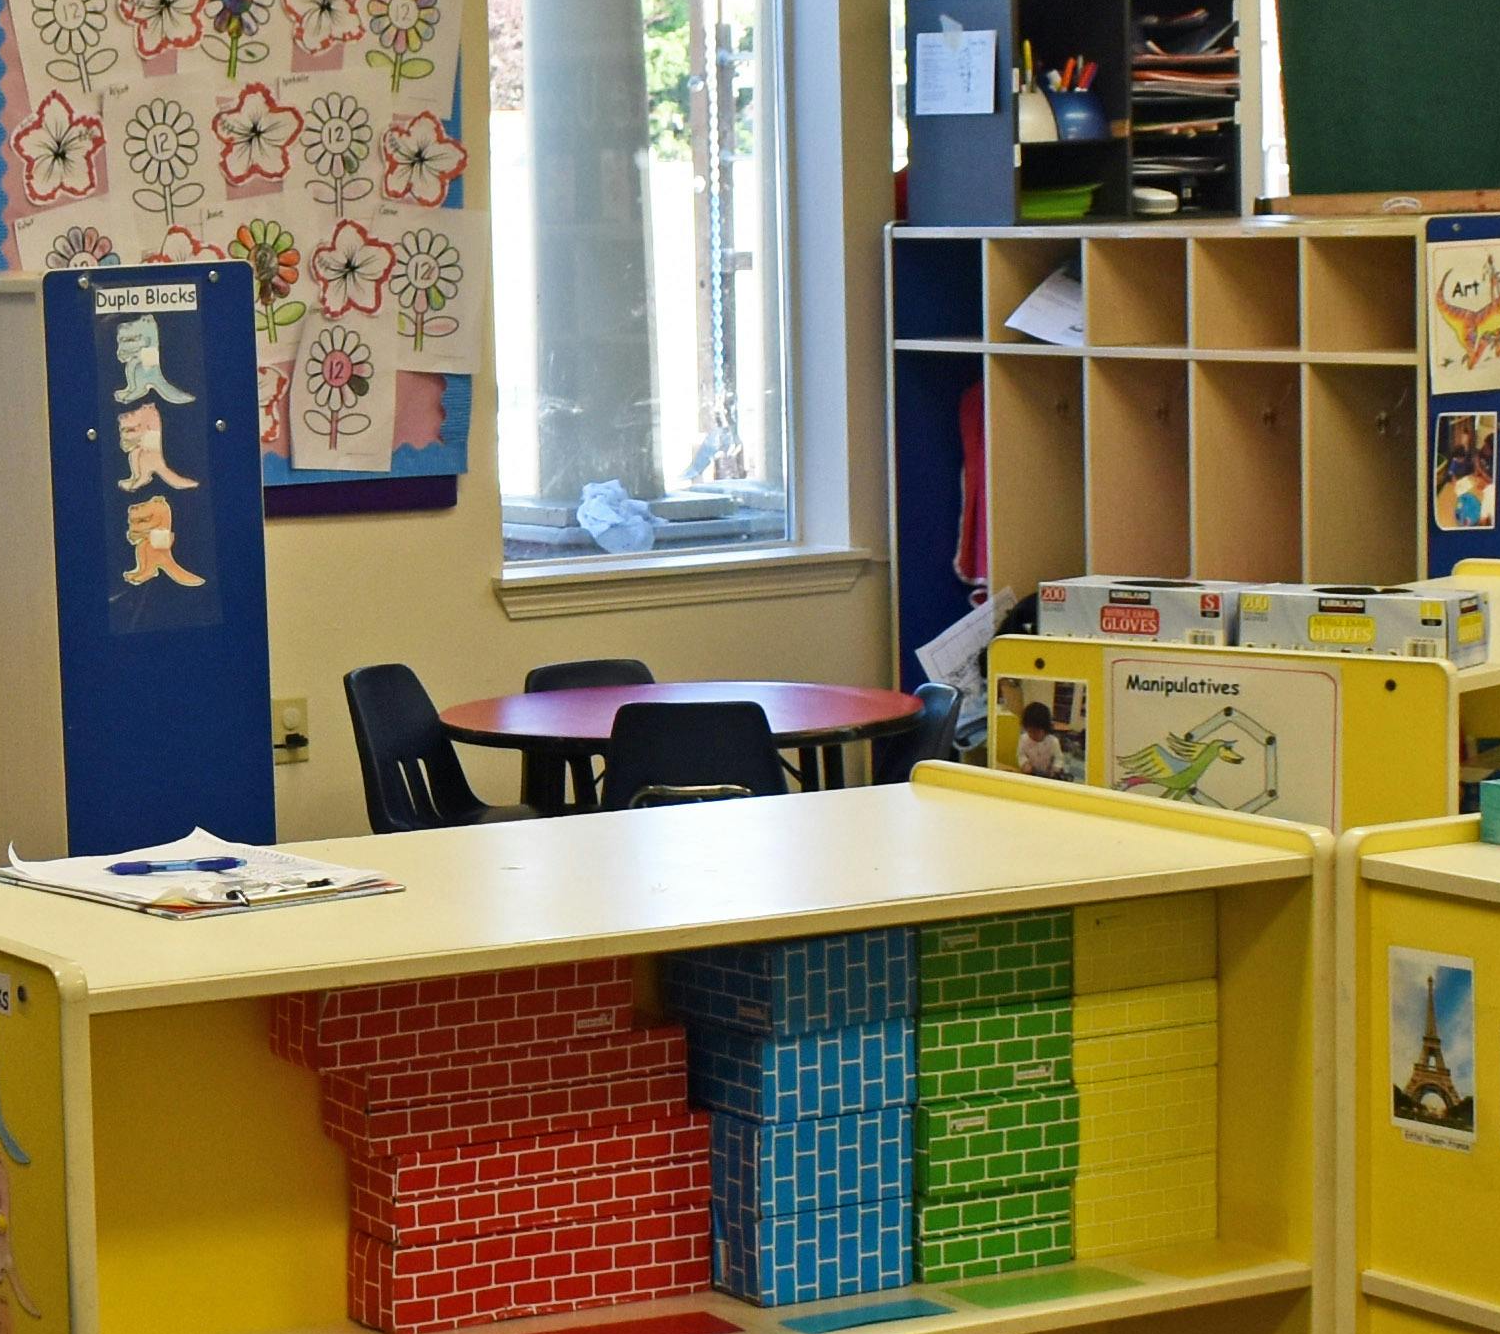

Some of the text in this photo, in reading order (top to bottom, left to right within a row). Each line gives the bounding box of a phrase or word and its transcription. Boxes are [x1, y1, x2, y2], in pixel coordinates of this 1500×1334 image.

[153, 132, 170, 155] 12
[328, 126, 346, 144] 12
[1451, 279, 1480, 298] Art
[96, 287, 197, 311] Duplo Blocks
[328, 361, 345, 380] 12
[1102, 617, 1158, 633] GLOVES
[1310, 626, 1372, 641] GLOVES
[1126, 674, 1240, 697] Manipulatives
